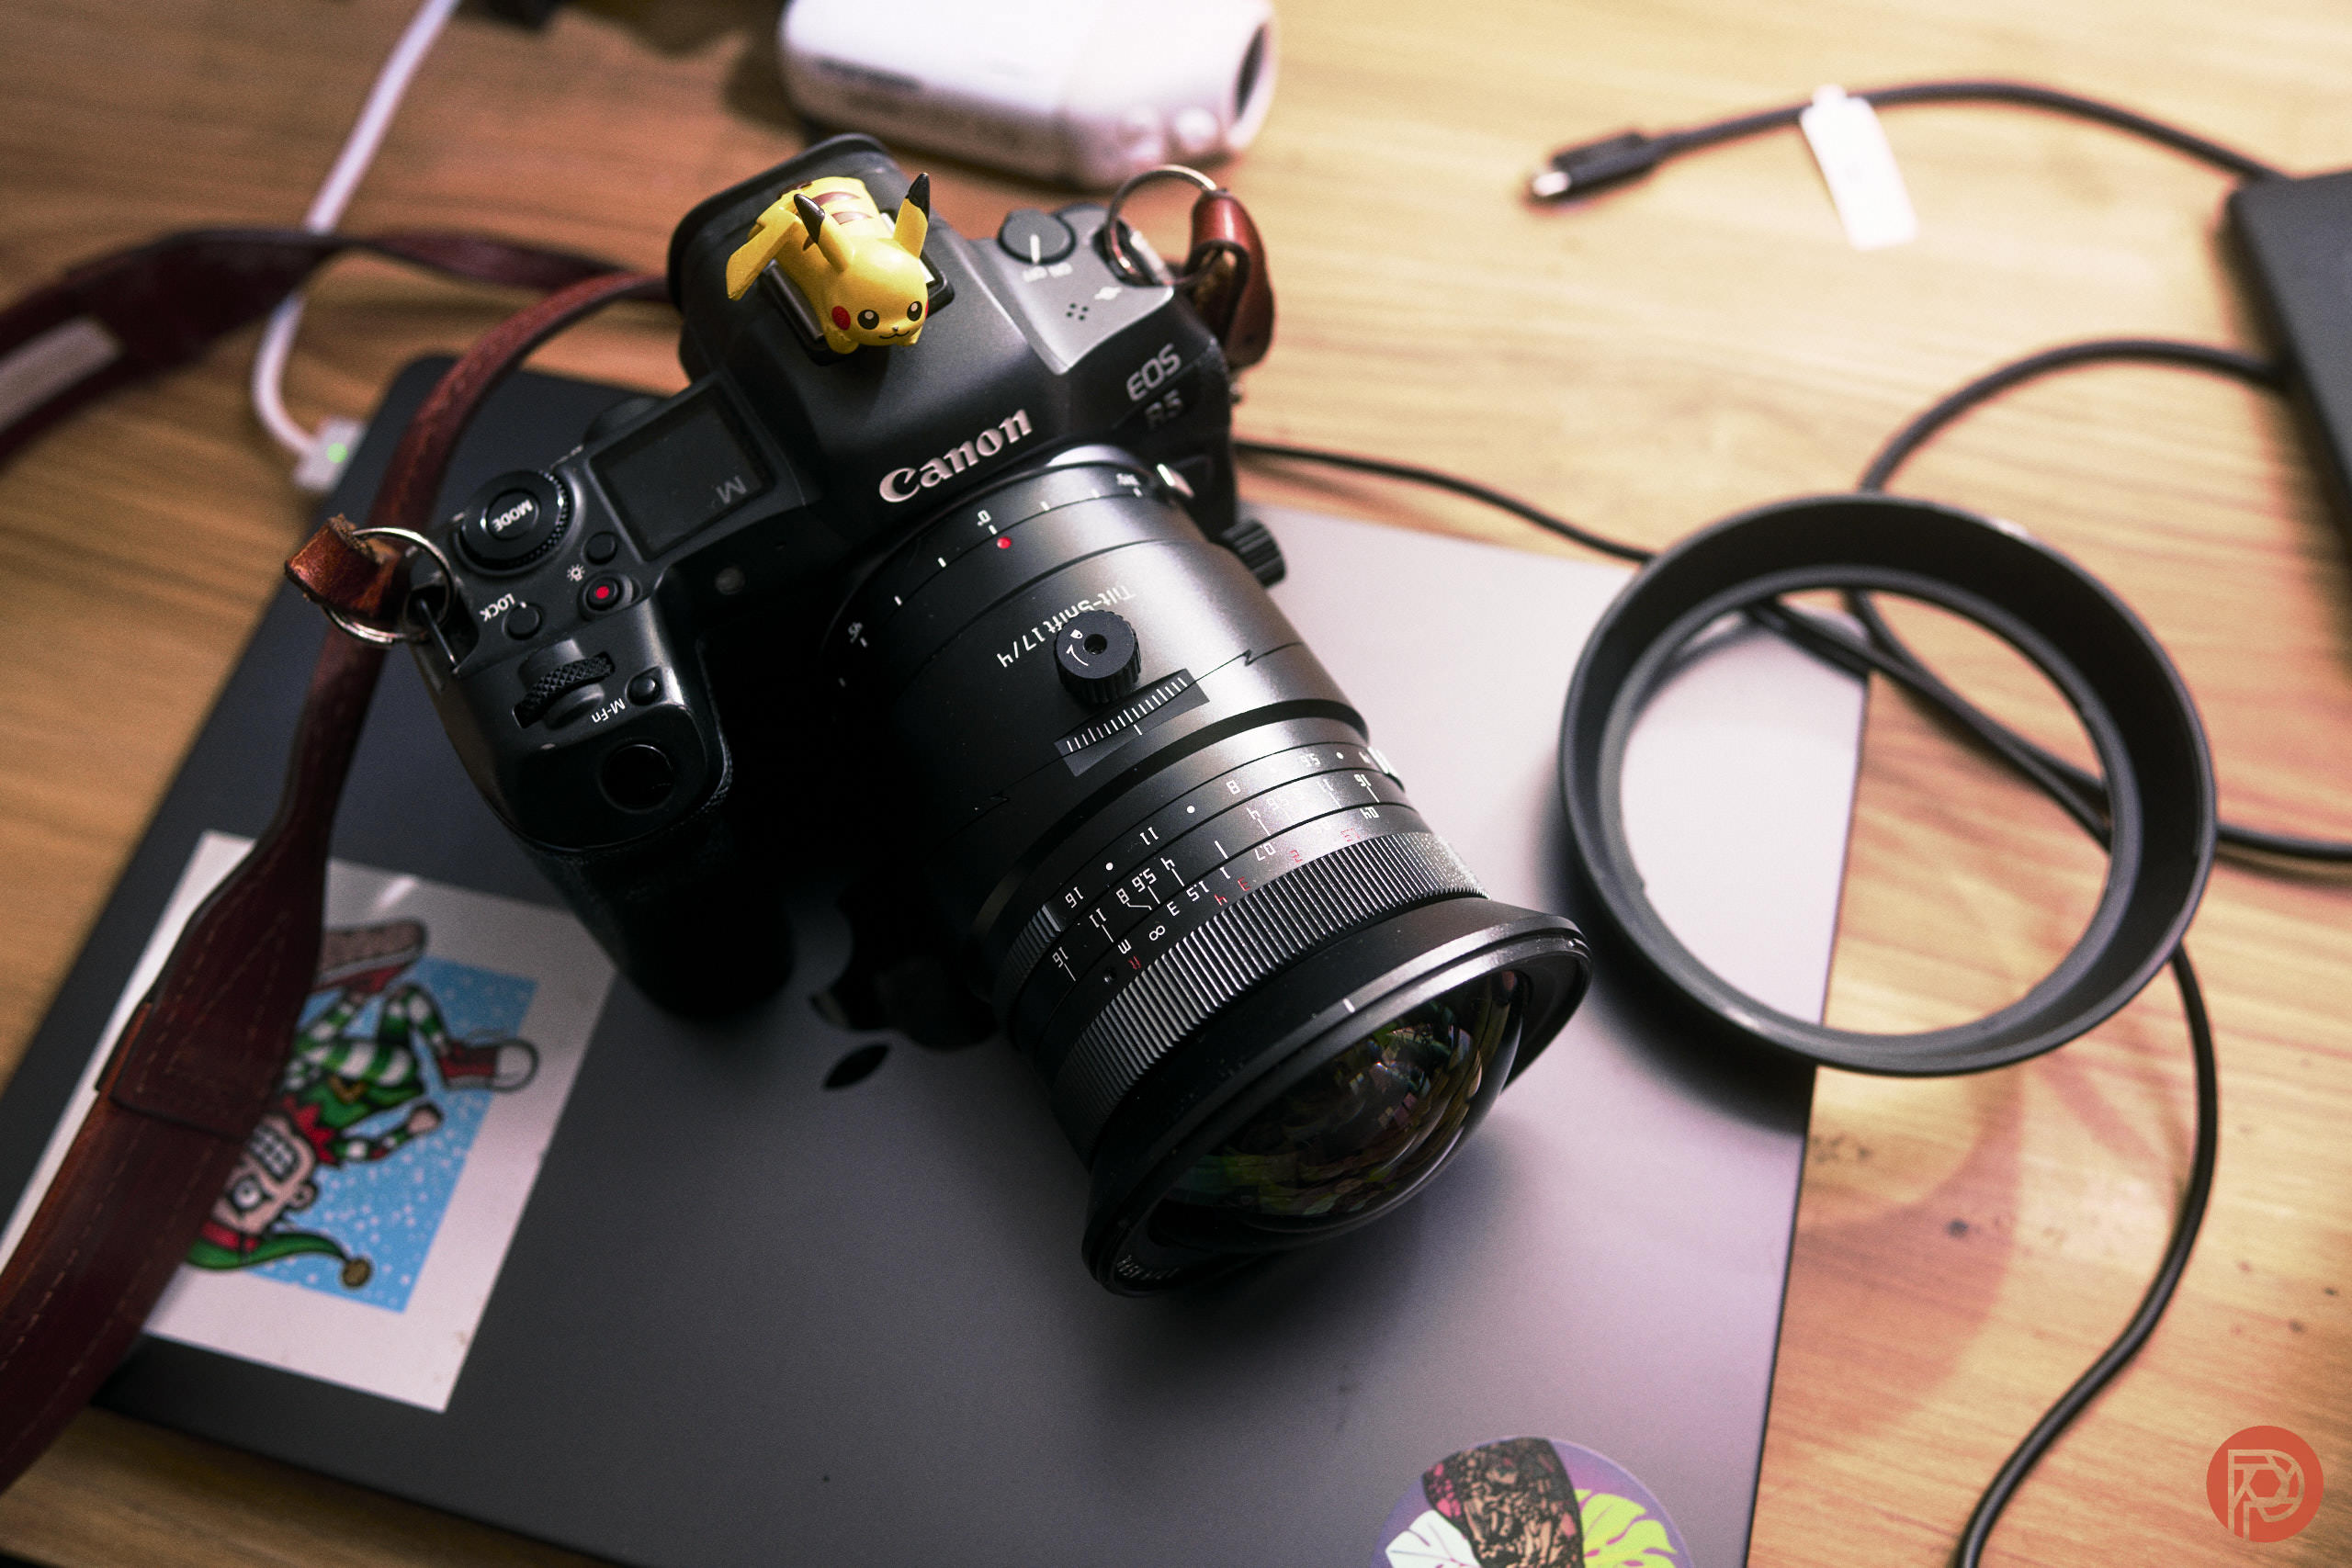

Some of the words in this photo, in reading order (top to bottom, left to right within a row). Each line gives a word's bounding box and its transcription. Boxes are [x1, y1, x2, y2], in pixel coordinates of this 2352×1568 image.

[1126, 344, 1182, 401] EOS
[878, 409, 1034, 503] Canon
[716, 476, 747, 504] M
[491, 498, 534, 533] MODE
[479, 592, 515, 623] LOCK
[997, 626, 1046, 668] 17/4
[591, 697, 627, 724] M-Fn
[1299, 752, 1321, 768] 5.6
[1227, 780, 1241, 795] 8
[1246, 807, 1261, 820] 4
[1139, 827, 1159, 846] 11
[1254, 841, 1277, 862] 0.7
[1160, 857, 1176, 871] 4
[1219, 866, 1231, 880] 1
[1131, 868, 1158, 893] 5.6
[1186, 880, 1210, 902] 1.5
[1237, 875, 1250, 892] 3
[1065, 886, 1084, 908] 16
[1115, 887, 1130, 905] 8
[1214, 894, 1228, 907] 4
[1089, 908, 1107, 928] 11
[1166, 901, 1181, 917] 3
[1052, 946, 1069, 968] 16
